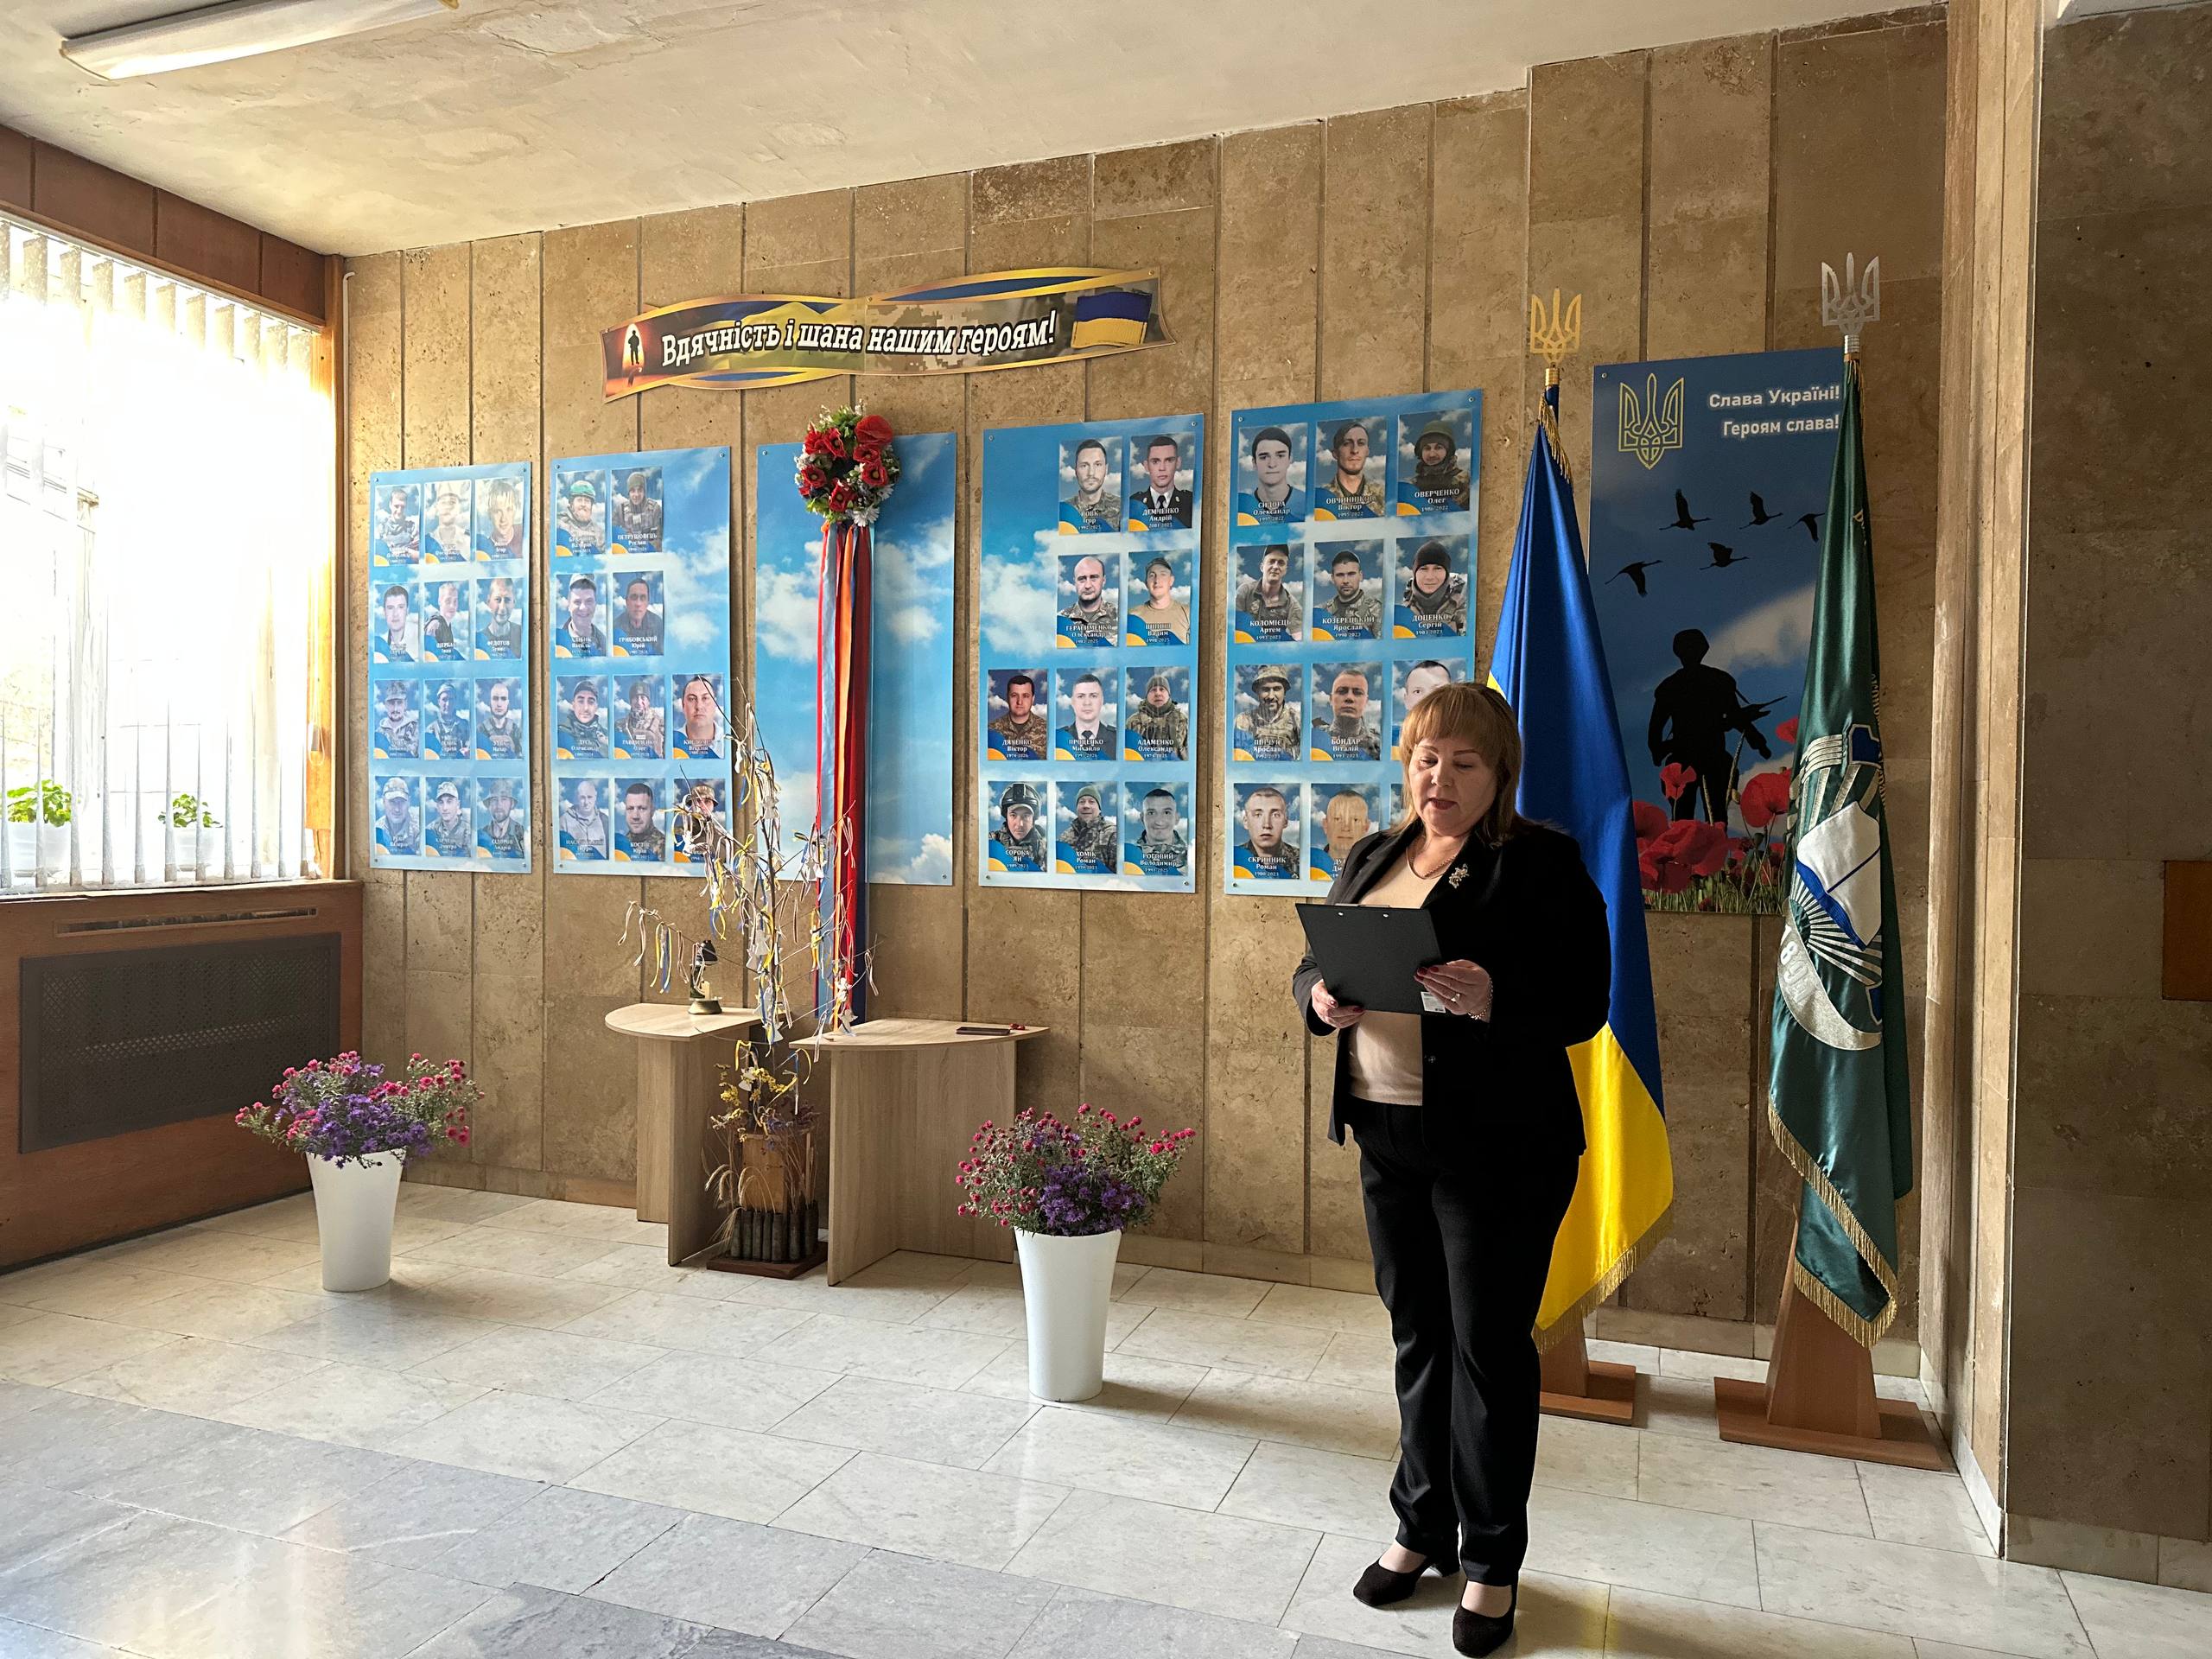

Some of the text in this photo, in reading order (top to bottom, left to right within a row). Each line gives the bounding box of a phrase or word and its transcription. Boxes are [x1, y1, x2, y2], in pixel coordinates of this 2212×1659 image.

[662, 310, 1057, 366] Вдячність і шана нашим героям!
[1709, 385, 1840, 408] Слава Україні!
[1724, 414, 1840, 438] Героям слава!
[1414, 488, 1460, 499] ОВЕРЧЕНКО
[1142, 507, 1179, 516] ДЕМЧЕНКО
[1412, 613, 1449, 622] ДОЦЕНКО
